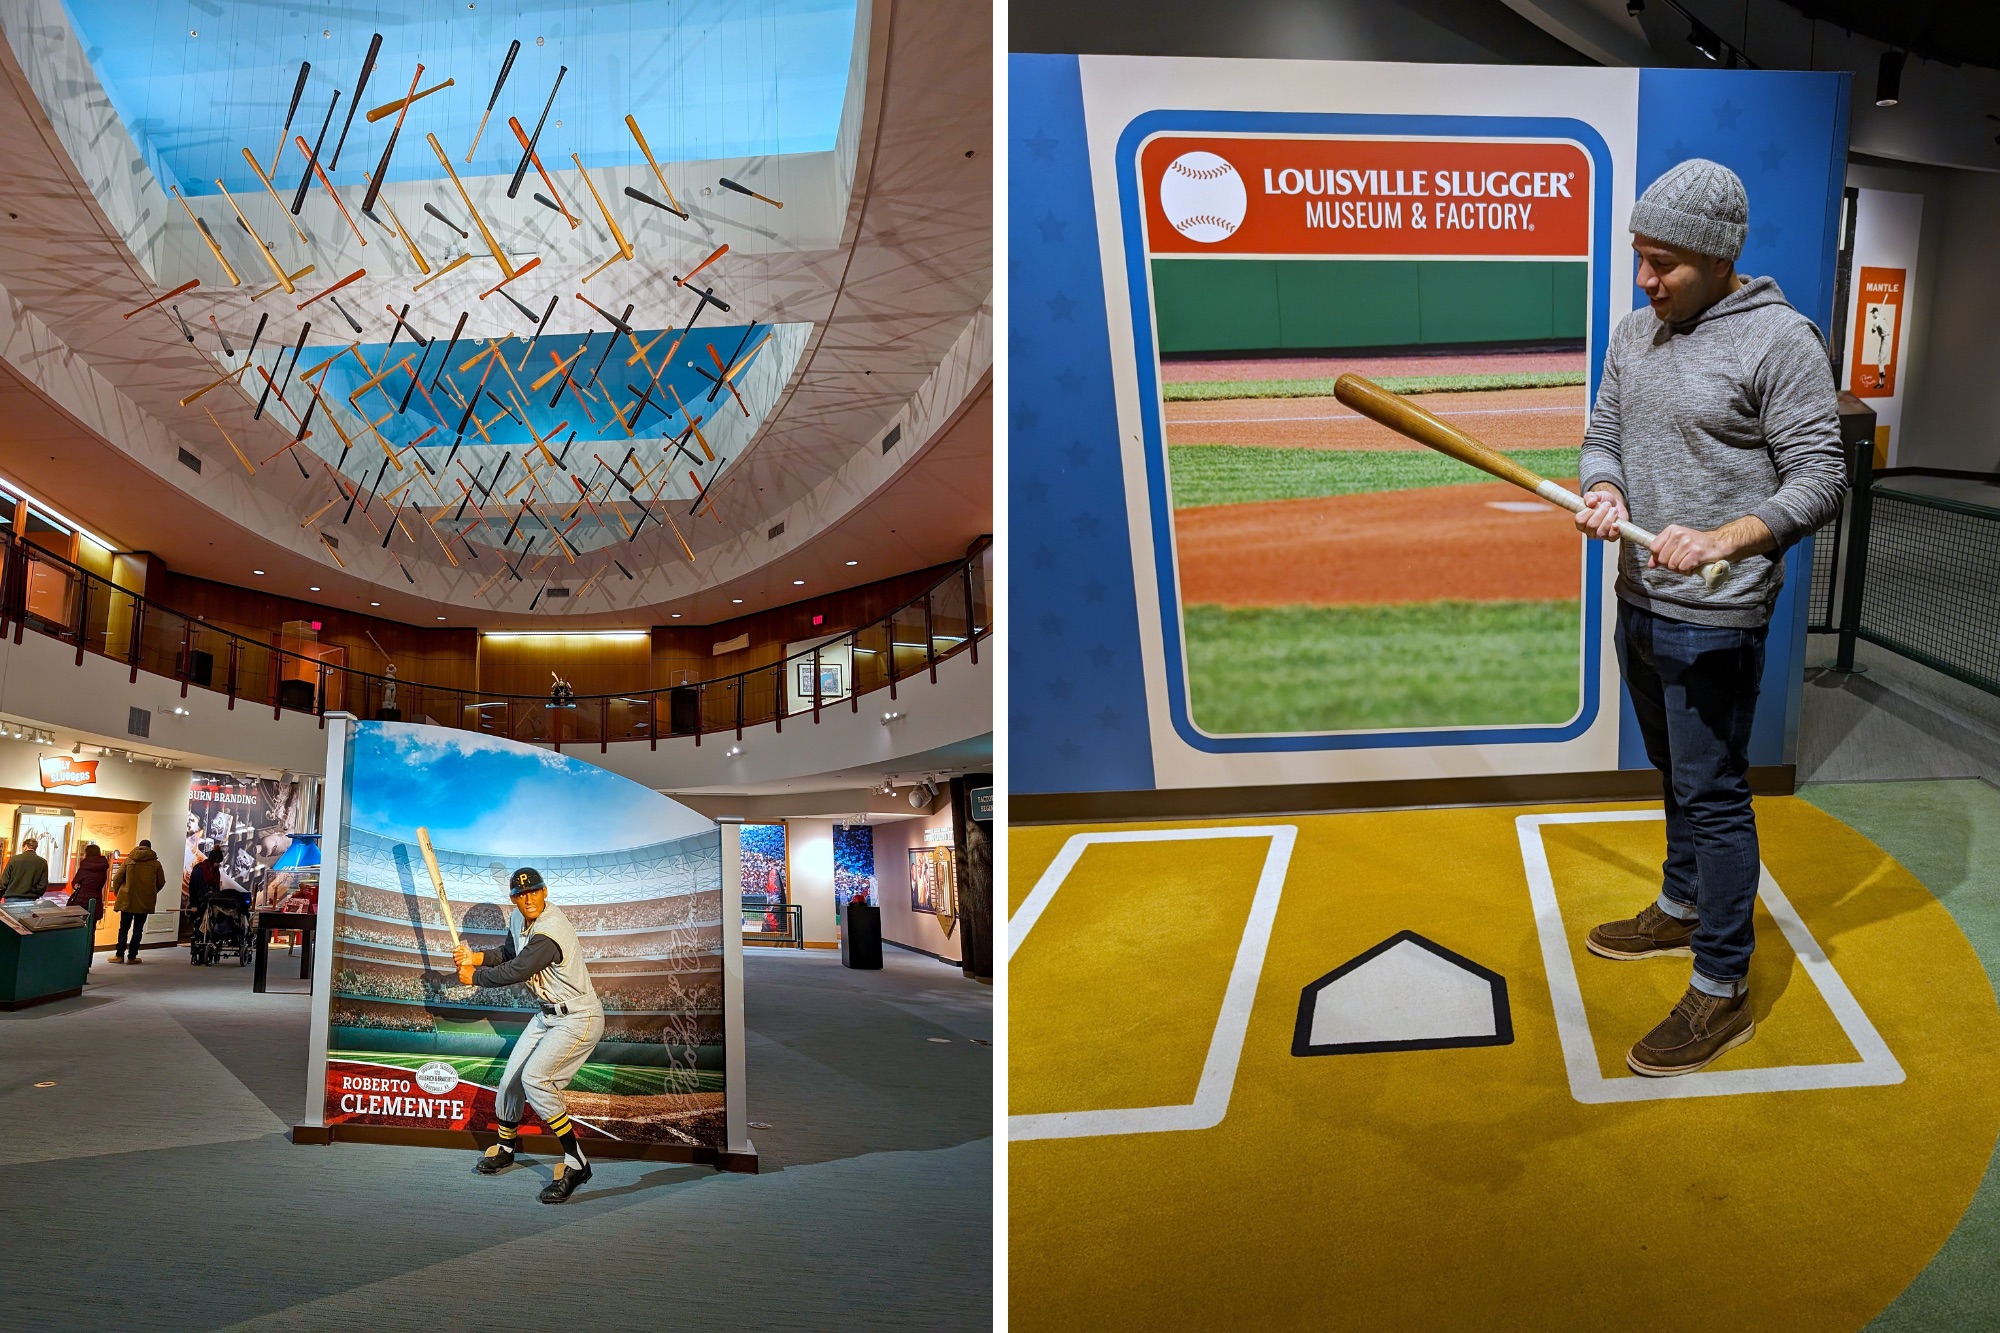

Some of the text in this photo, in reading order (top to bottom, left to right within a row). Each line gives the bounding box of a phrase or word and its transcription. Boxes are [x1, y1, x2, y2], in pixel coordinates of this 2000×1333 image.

[1264, 168, 1429, 196] LOUISVILLE
[1306, 201, 1402, 229] MUSEUM
[1411, 202, 1427, 230] &
[1866, 283, 1899, 292] MANTLE
[188, 790, 257, 805] BURN BRANDING
[520, 873, 527, 885] P
[342, 1076, 411, 1093] ROBERTO
[340, 1094, 464, 1120] CLEMENTE
